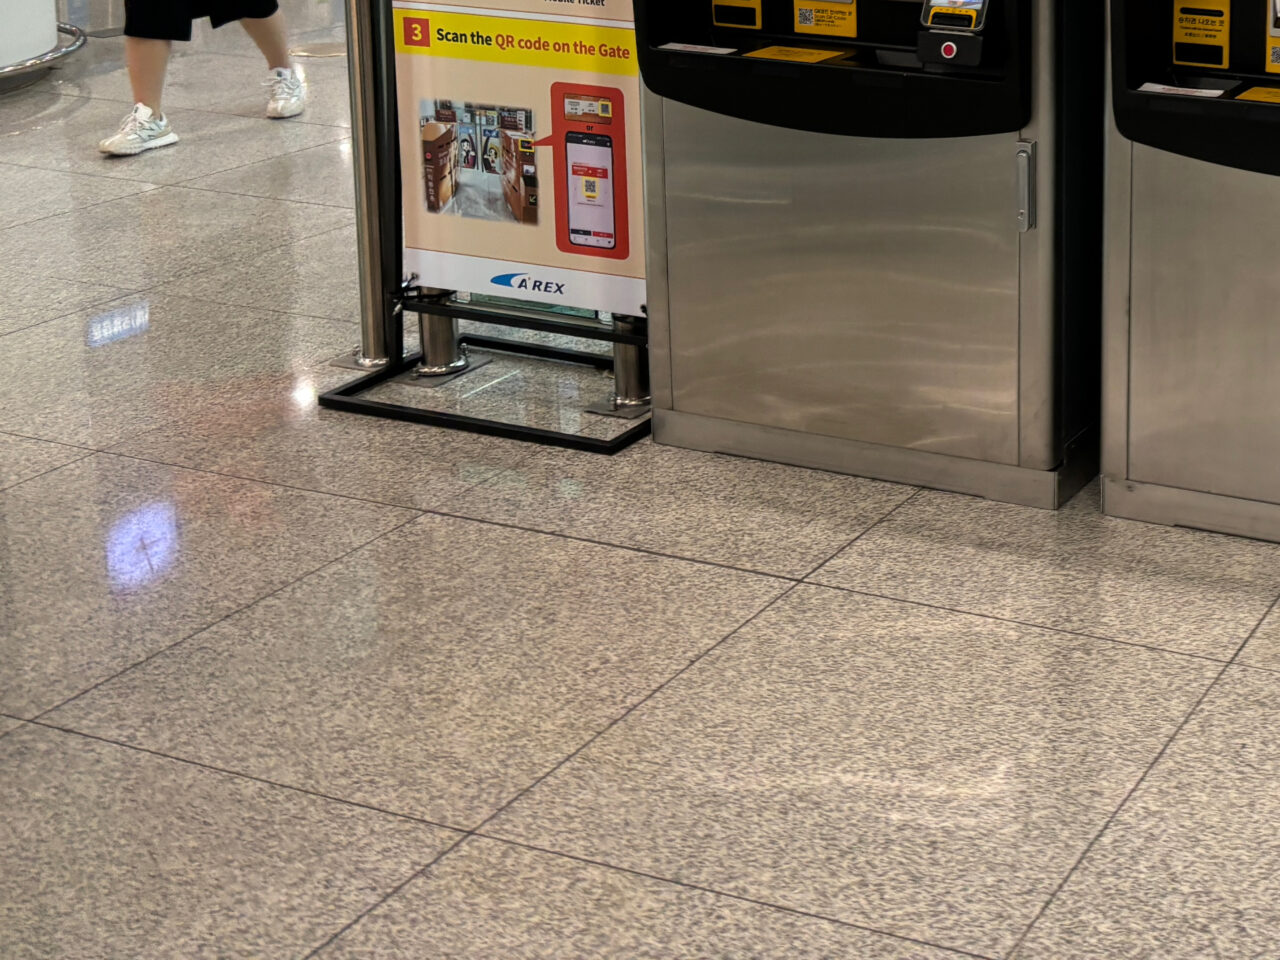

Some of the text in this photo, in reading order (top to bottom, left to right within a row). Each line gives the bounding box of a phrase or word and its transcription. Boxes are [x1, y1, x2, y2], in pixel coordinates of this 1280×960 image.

[411, 23, 422, 41] 3
[436, 28, 631, 59] Scan the QR code on the Gate
